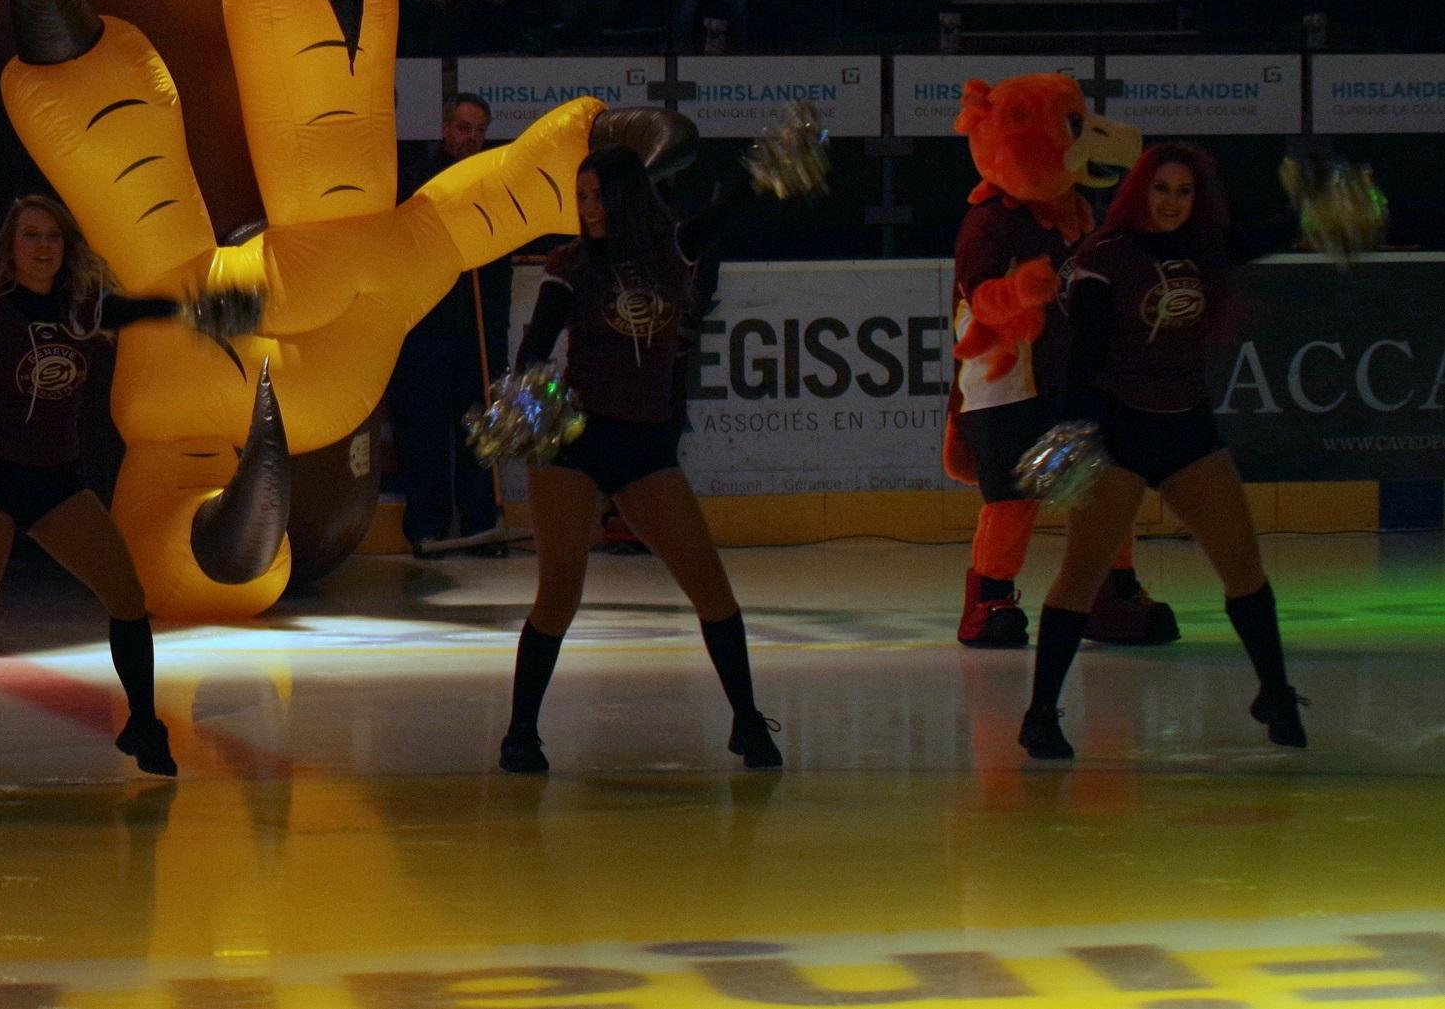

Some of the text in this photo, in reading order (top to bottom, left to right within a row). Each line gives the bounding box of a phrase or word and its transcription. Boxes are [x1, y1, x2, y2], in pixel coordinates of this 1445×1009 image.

[479, 87, 621, 102] HIRSLANDEN
[697, 84, 836, 101] HIRSLANDEN
[914, 83, 962, 100] HIRS
[1124, 83, 1258, 100] HIRSLANDEN
[697, 108, 756, 119] CLINIQUE
[761, 108, 777, 118] LA
[704, 408, 941, 432] ASSOCIÉS EN TOUT
[709, 475, 933, 492] Conseil Gérance Courtage
